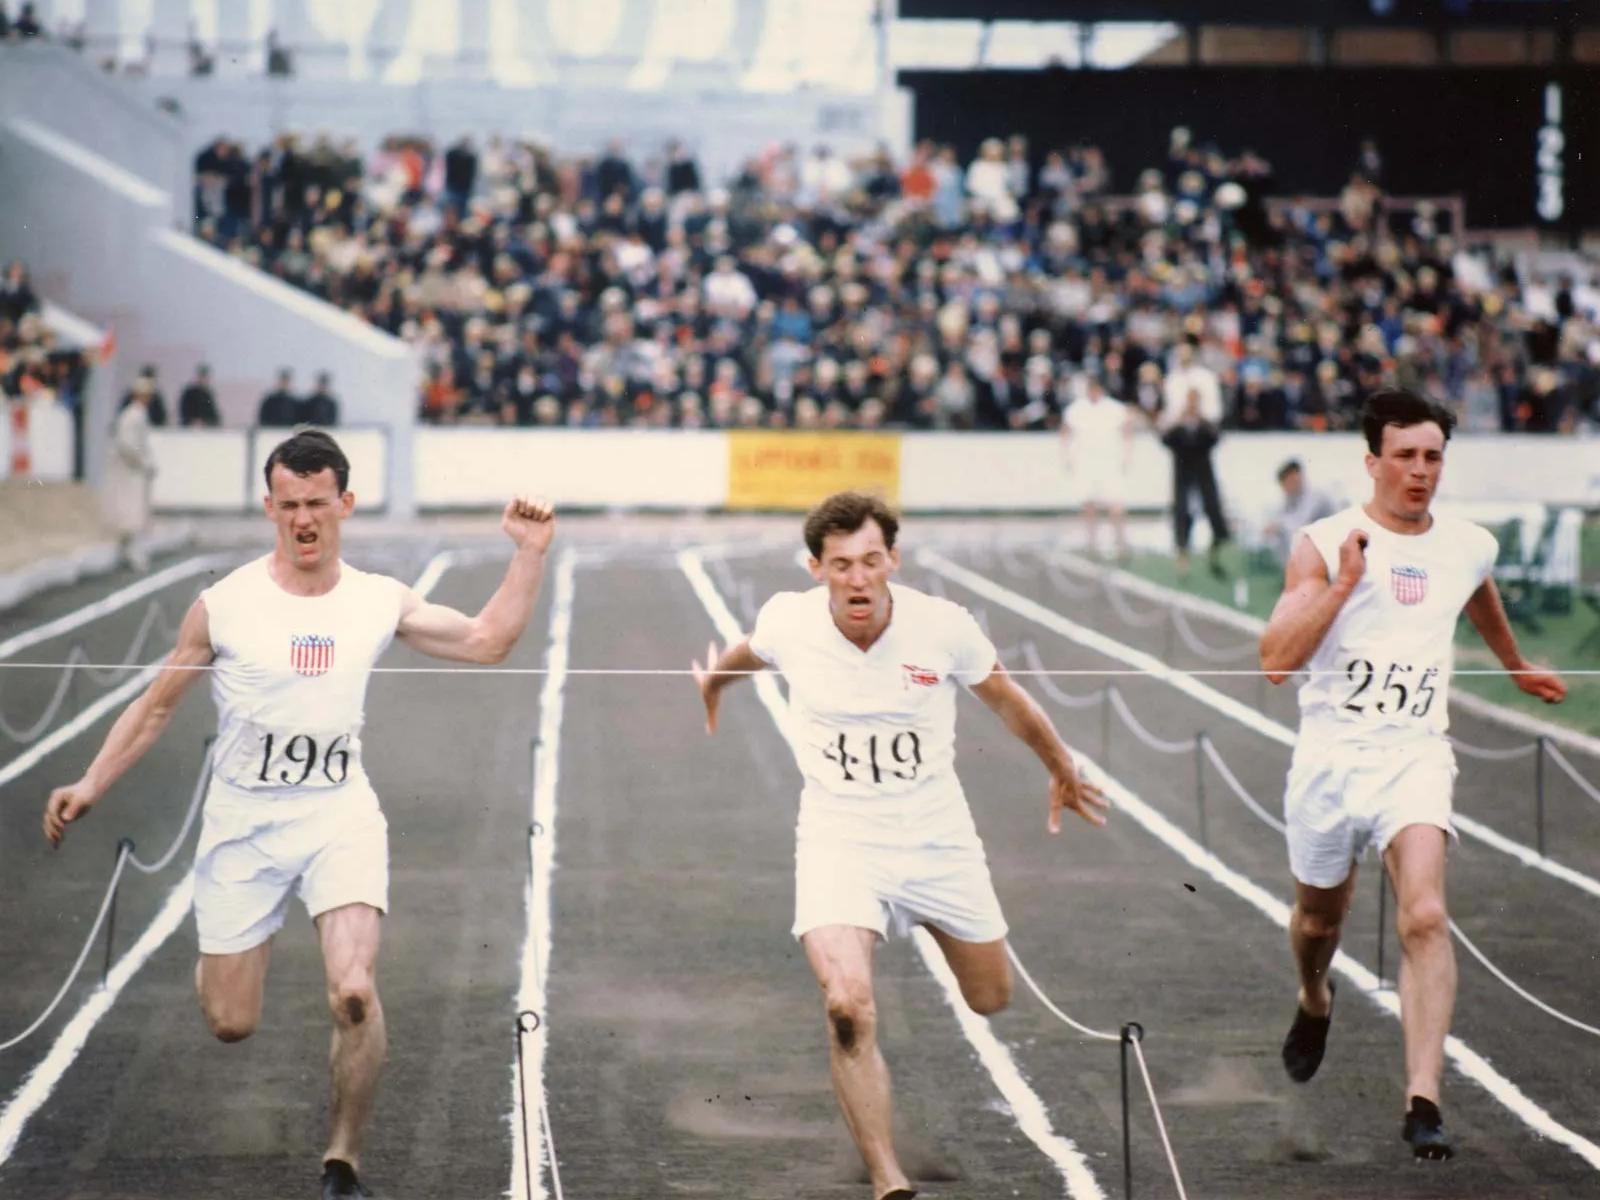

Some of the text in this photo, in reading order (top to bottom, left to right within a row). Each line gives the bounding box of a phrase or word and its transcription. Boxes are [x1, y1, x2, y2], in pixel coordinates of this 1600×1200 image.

[1344, 659, 1438, 717] 255
[258, 733, 350, 785] 196
[822, 731, 922, 783] 419
